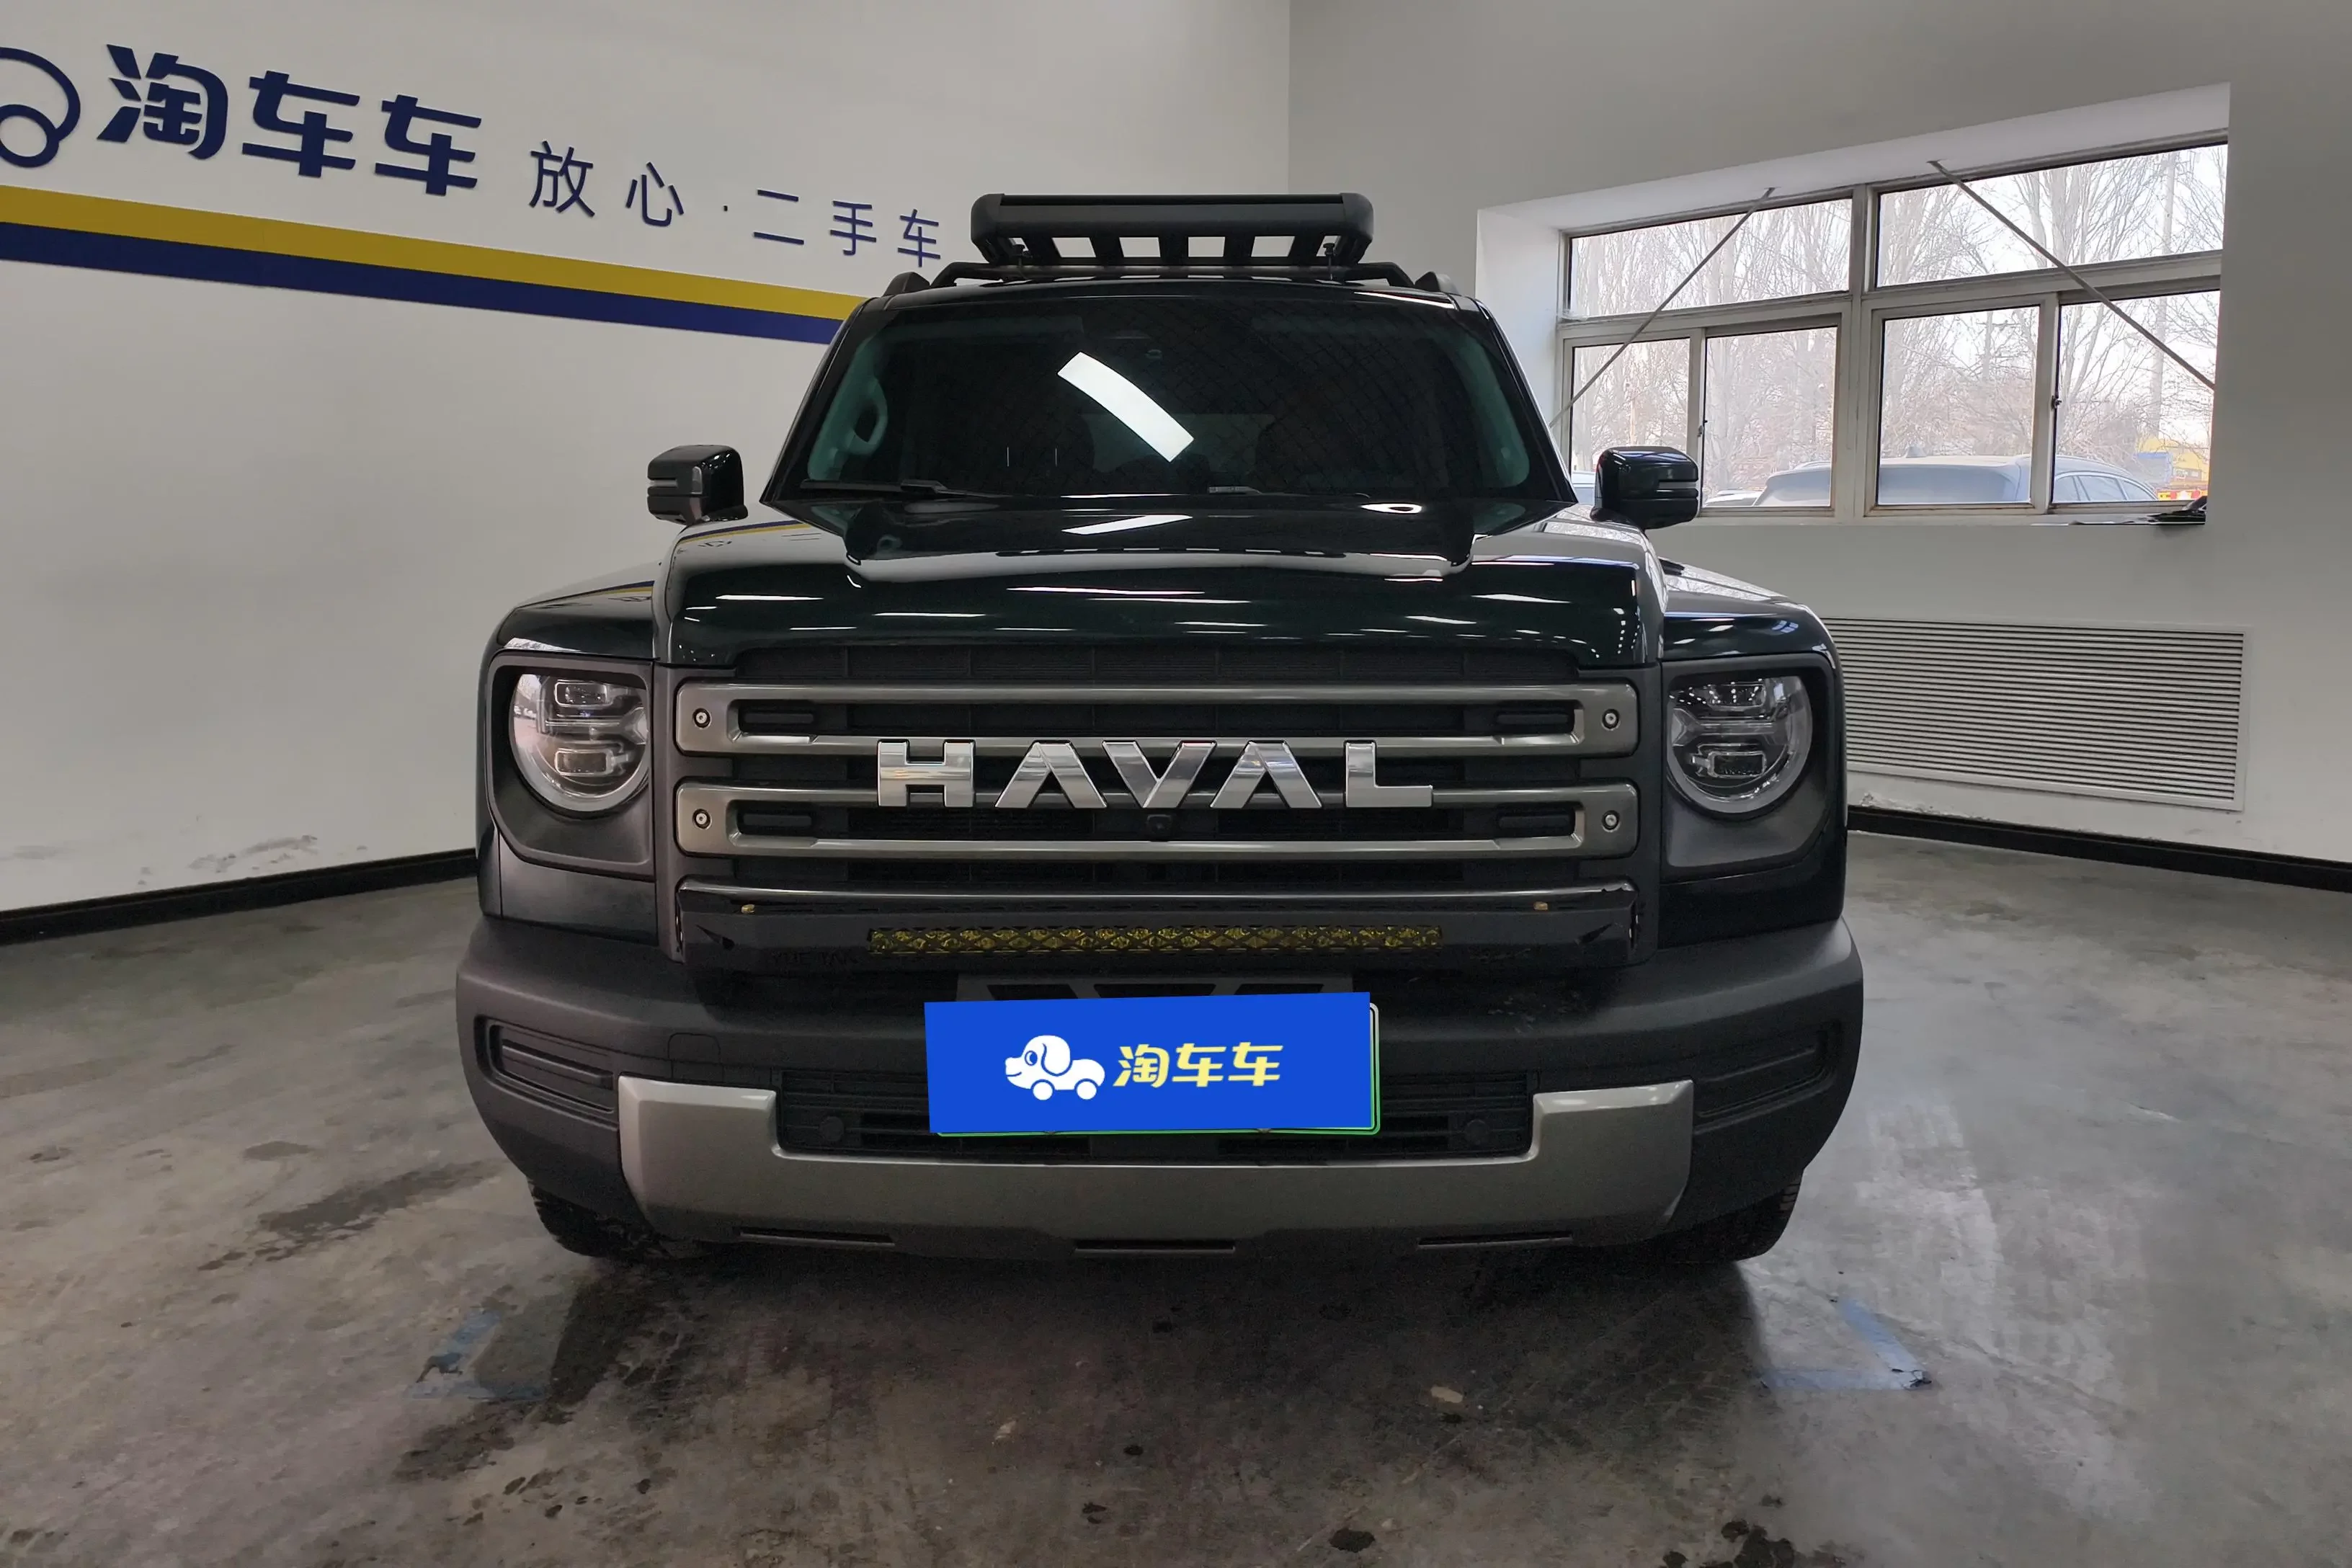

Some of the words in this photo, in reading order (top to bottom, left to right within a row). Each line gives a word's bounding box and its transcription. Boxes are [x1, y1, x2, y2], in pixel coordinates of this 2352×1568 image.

[97, 44, 482, 196] 淘车车
[876, 739, 1433, 808] HAVAL
